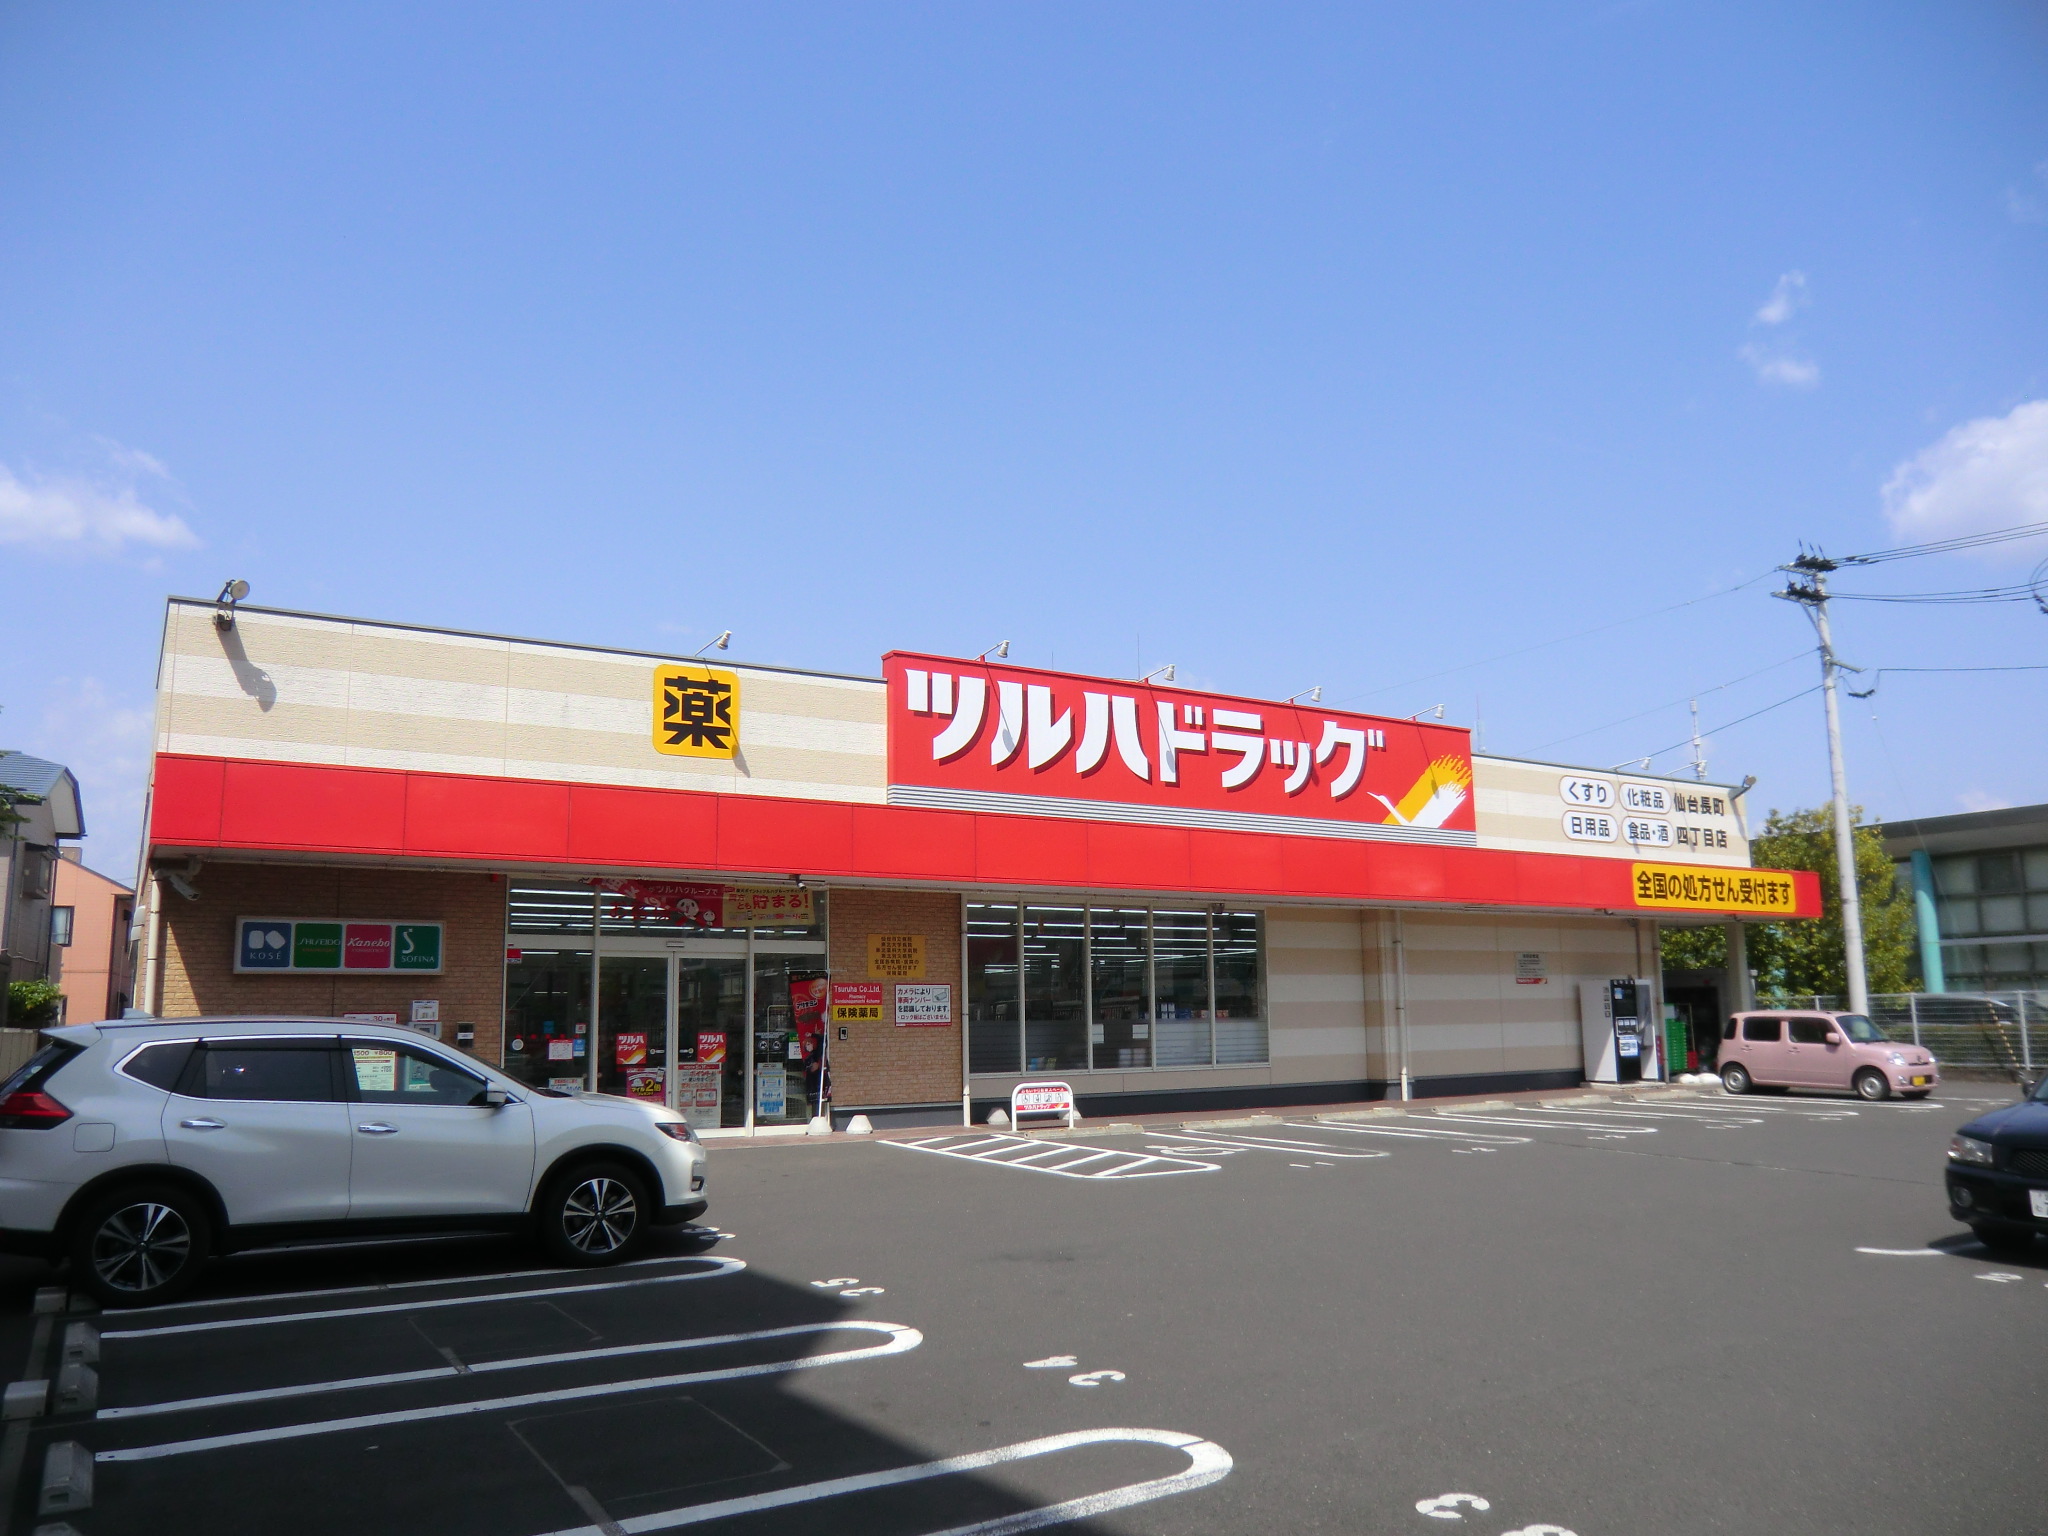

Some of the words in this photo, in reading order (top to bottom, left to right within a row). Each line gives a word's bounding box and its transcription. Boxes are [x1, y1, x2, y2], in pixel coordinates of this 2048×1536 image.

[663, 675, 731, 750] 薬
[906, 668, 1386, 798] ツルハドラッグ
[1567, 781, 1607, 803] くすり
[1627, 787, 1664, 810] 化粧品
[1673, 792, 1725, 817] 仙台長町
[1571, 816, 1610, 838] 日用品
[1628, 820, 1669, 843] 食品・酒
[1676, 825, 1728, 849] 四丁目店
[1636, 869, 1792, 906] 全国の処方せん受付ます
[299, 936, 341, 946] SHISEIDO
[347, 937, 390, 948] Kanebo
[249, 950, 282, 960] KOSÉ
[401, 955, 435, 963] SOFINA
[834, 985, 858, 993] Tsuruha
[897, 987, 931, 996] カメラにより
[897, 996, 931, 1004] 車両ナンバー
[837, 1007, 879, 1019] 保険薬局
[618, 1035, 645, 1044] ツルハ
[699, 1034, 724, 1043] ツルハ
